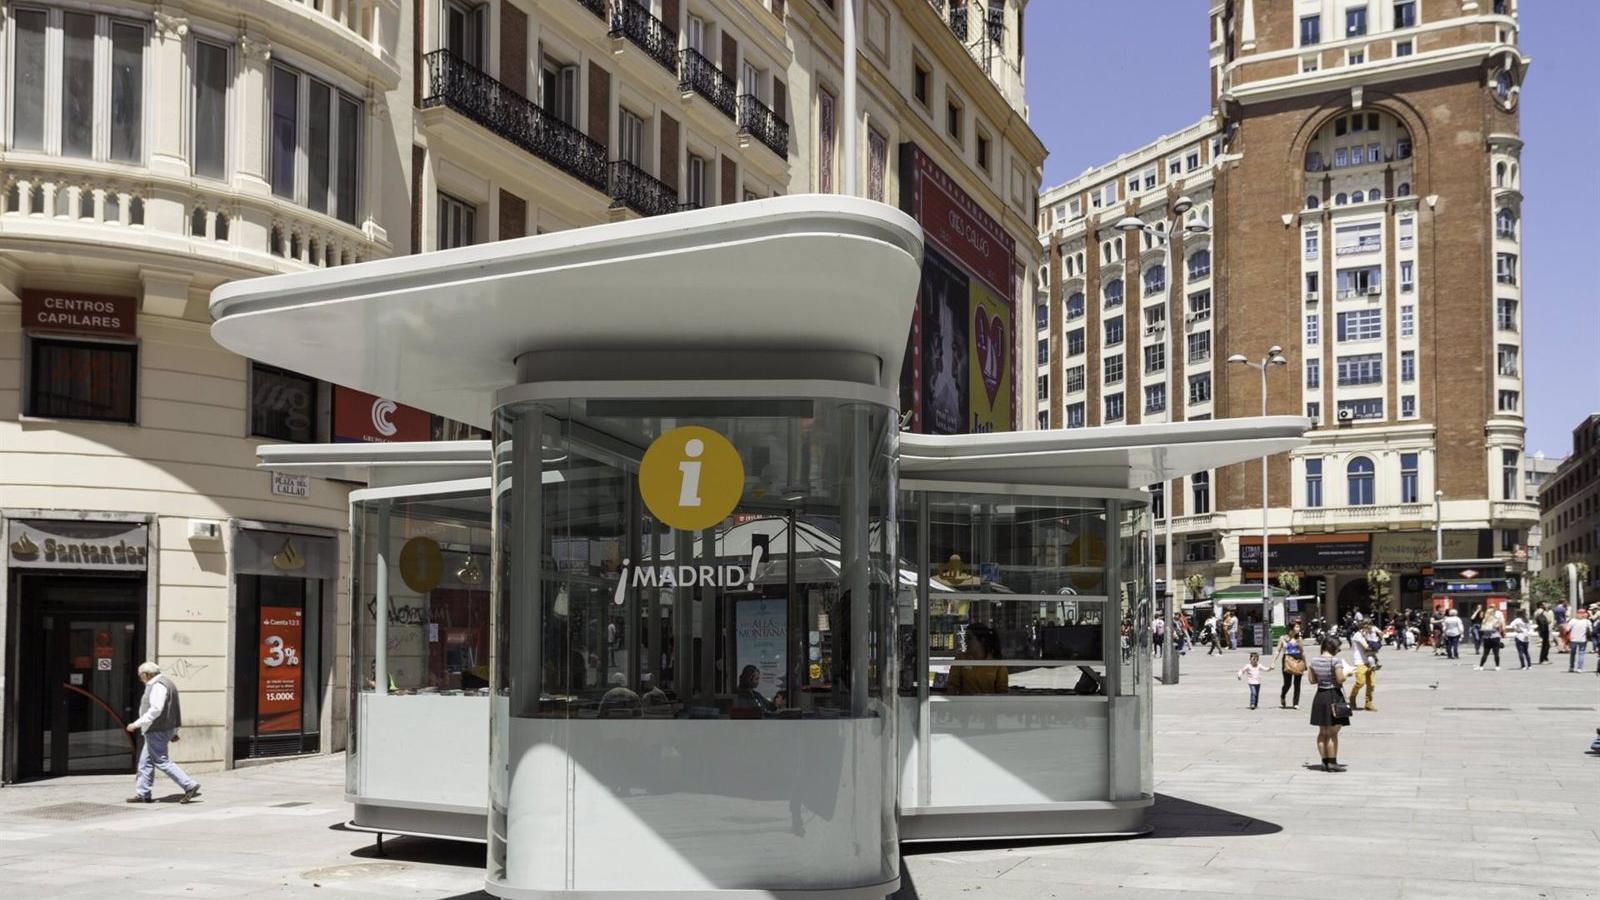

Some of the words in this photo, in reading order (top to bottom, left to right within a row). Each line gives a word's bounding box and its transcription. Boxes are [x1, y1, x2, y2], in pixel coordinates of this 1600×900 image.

[44, 297, 115, 314] CENTROS
[37, 311, 121, 328] CAPILARES
[275, 477, 295, 486] PLAZA
[277, 485, 306, 496] CALLAO
[43, 538, 146, 563] Santander
[614, 545, 764, 605] ¡MADRID!
